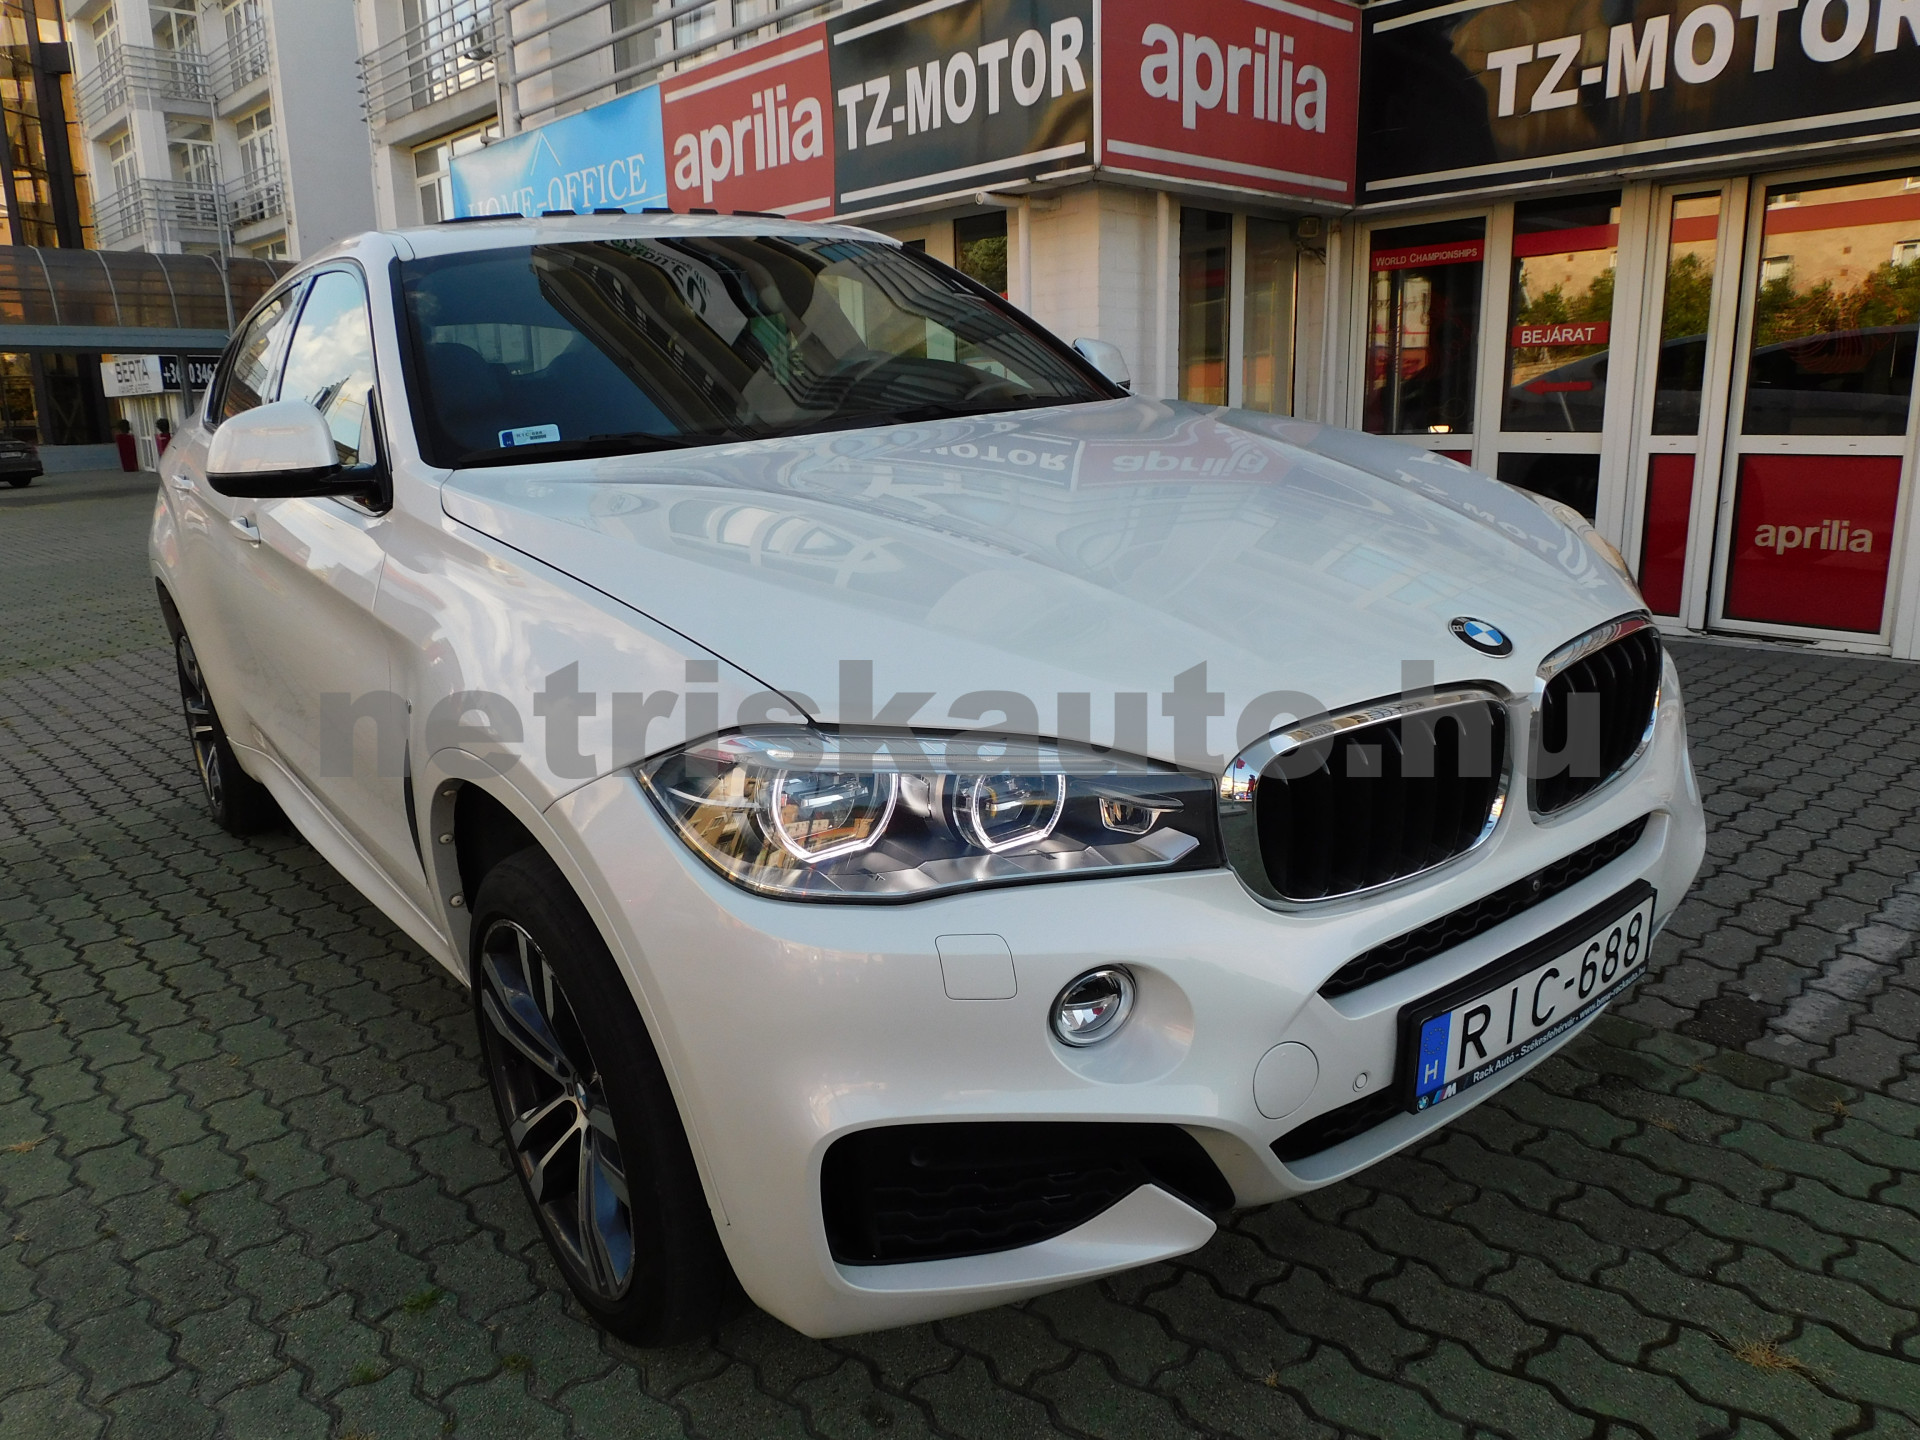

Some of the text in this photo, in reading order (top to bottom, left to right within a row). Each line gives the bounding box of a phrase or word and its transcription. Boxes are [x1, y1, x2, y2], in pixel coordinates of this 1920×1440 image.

[838, 16, 1086, 150] TZ-MOTOR
[1140, 23, 1327, 134] aprilia
[1487, 0, 1920, 117] TZ-MOTOR
[673, 83, 824, 203] aprilia
[115, 358, 150, 383] BERTA
[1521, 326, 1595, 344] BEJÁRAT
[1754, 519, 1873, 555] aprilia
[1424, 912, 1643, 1084] H RIC-688
[1473, 1067, 1494, 1083] Rack
[1495, 1055, 1515, 1071] Autó
